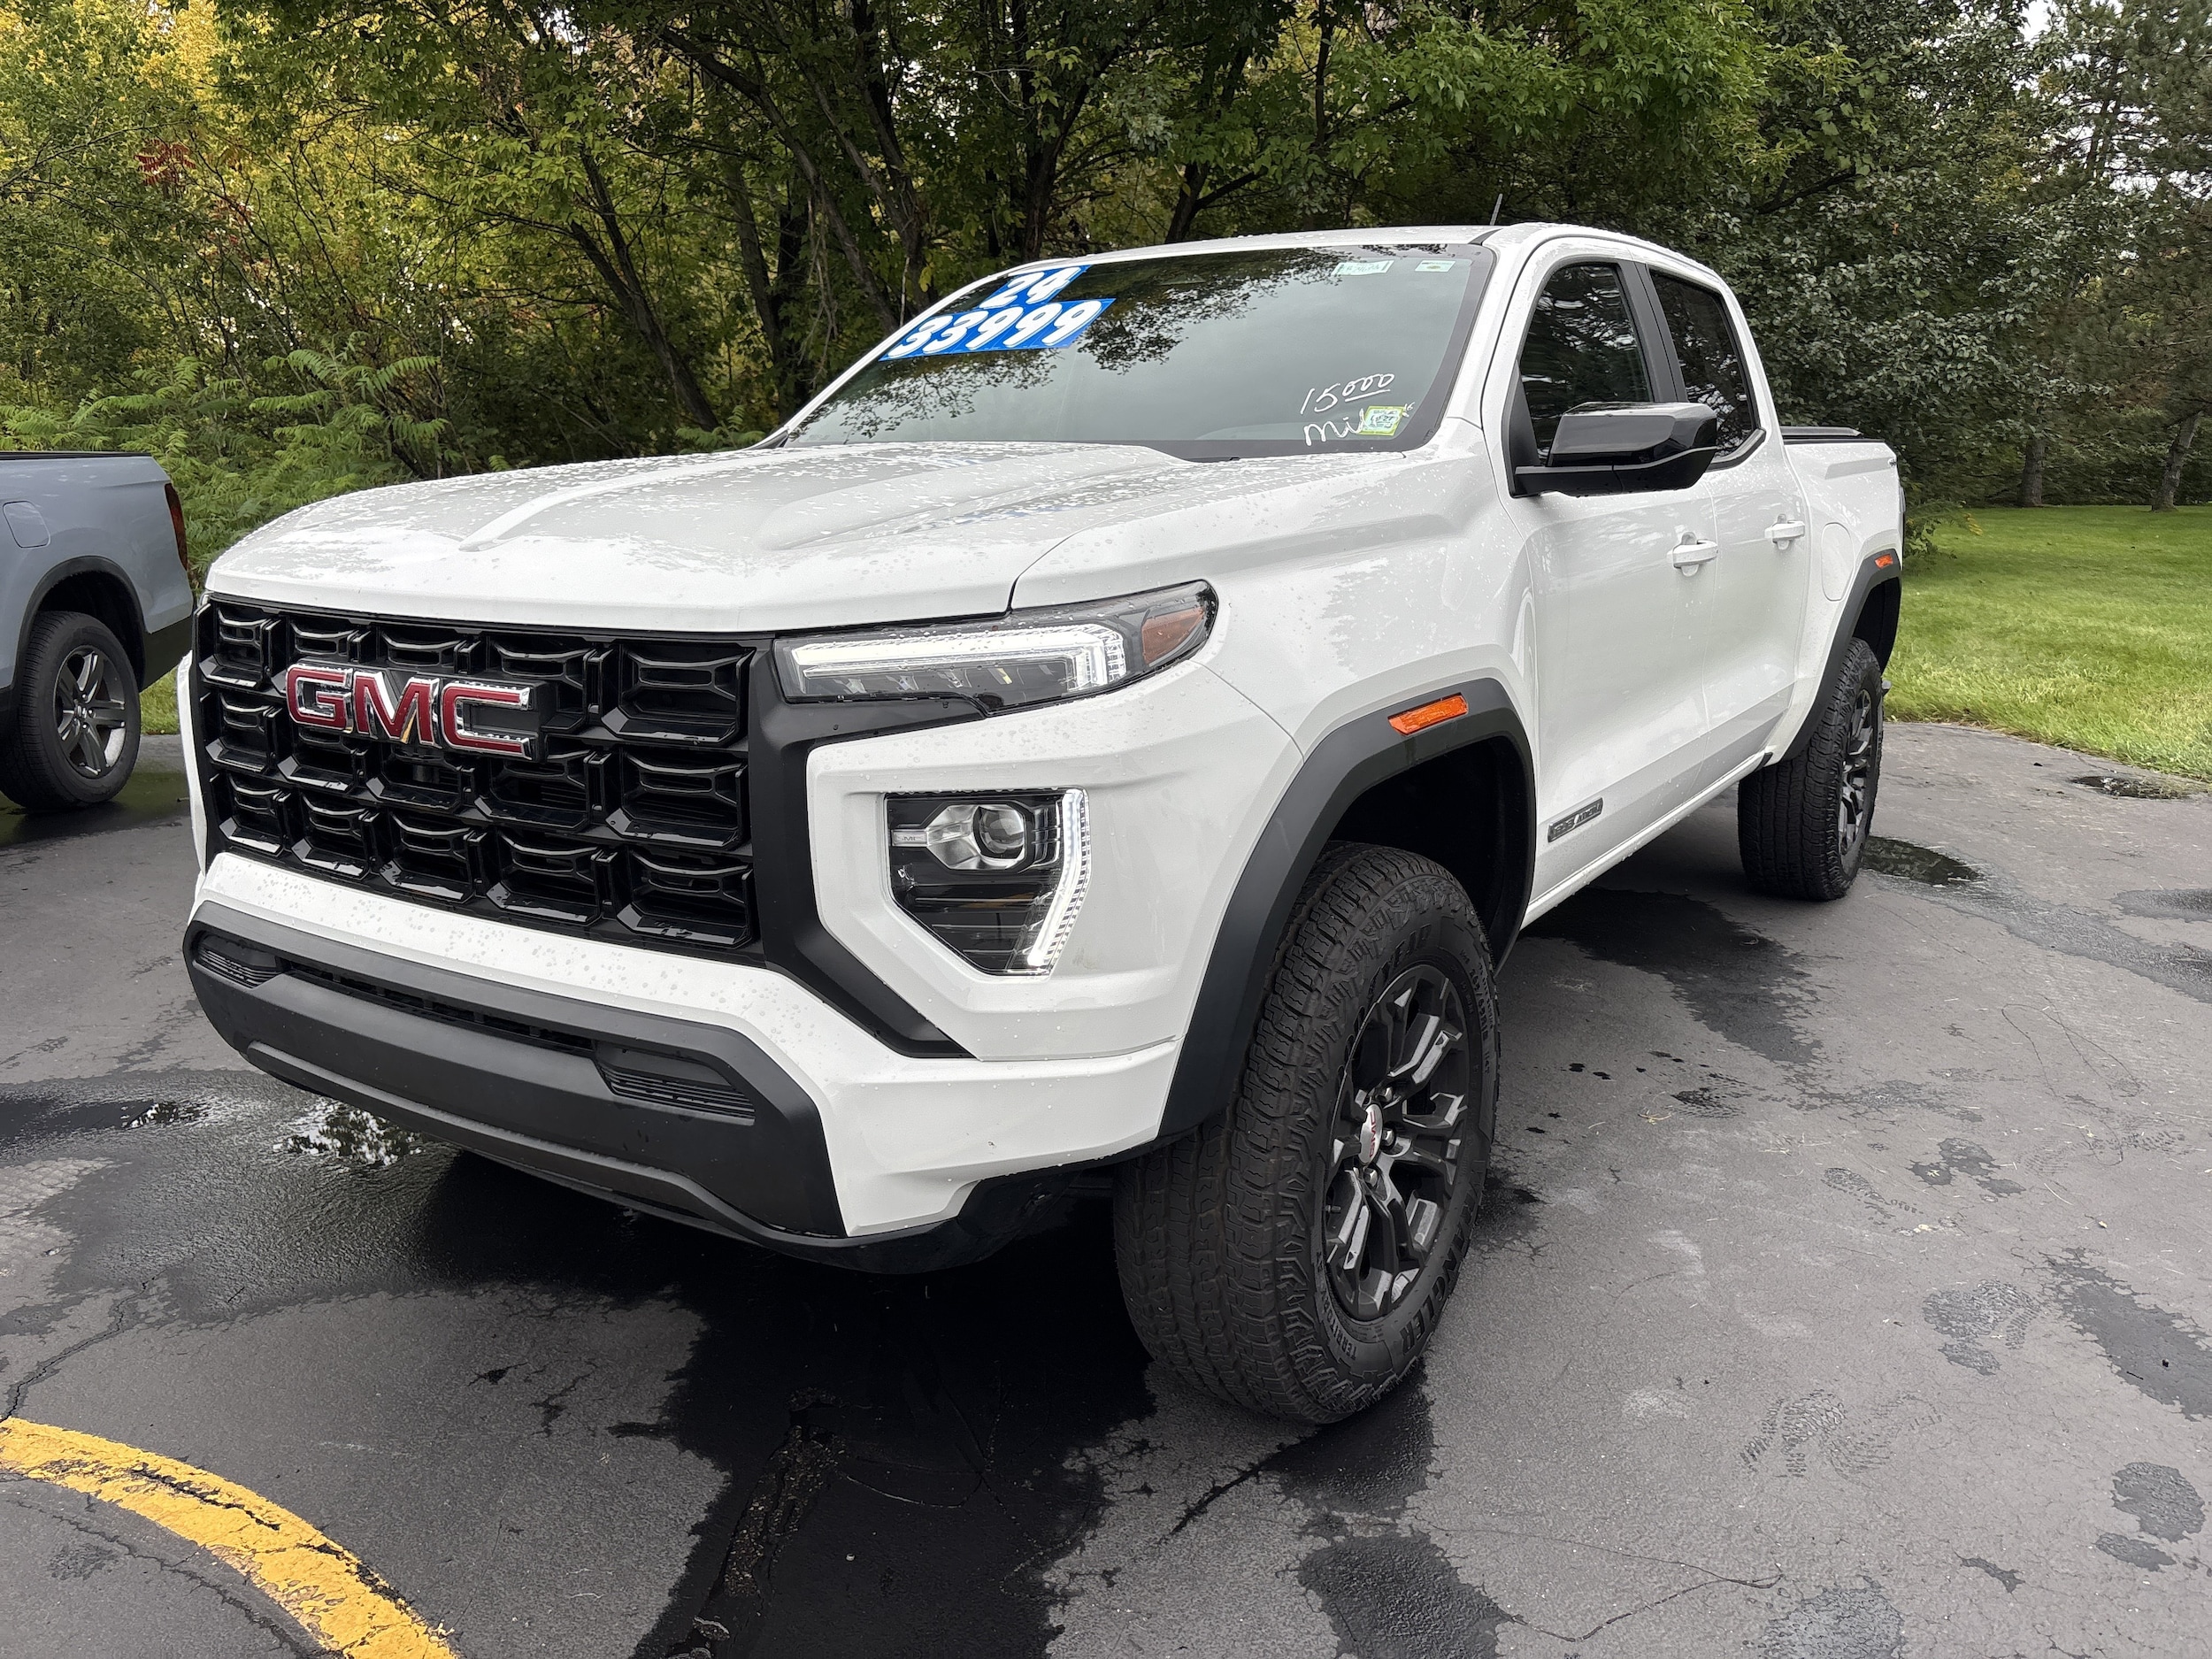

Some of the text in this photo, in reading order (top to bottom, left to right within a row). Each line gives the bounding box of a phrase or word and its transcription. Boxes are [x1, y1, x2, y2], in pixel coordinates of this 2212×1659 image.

[979, 266, 1081, 309] 24
[887, 300, 1102, 357] 33999
[1300, 373, 1395, 414] 15000
[286, 664, 533, 761] GMC
